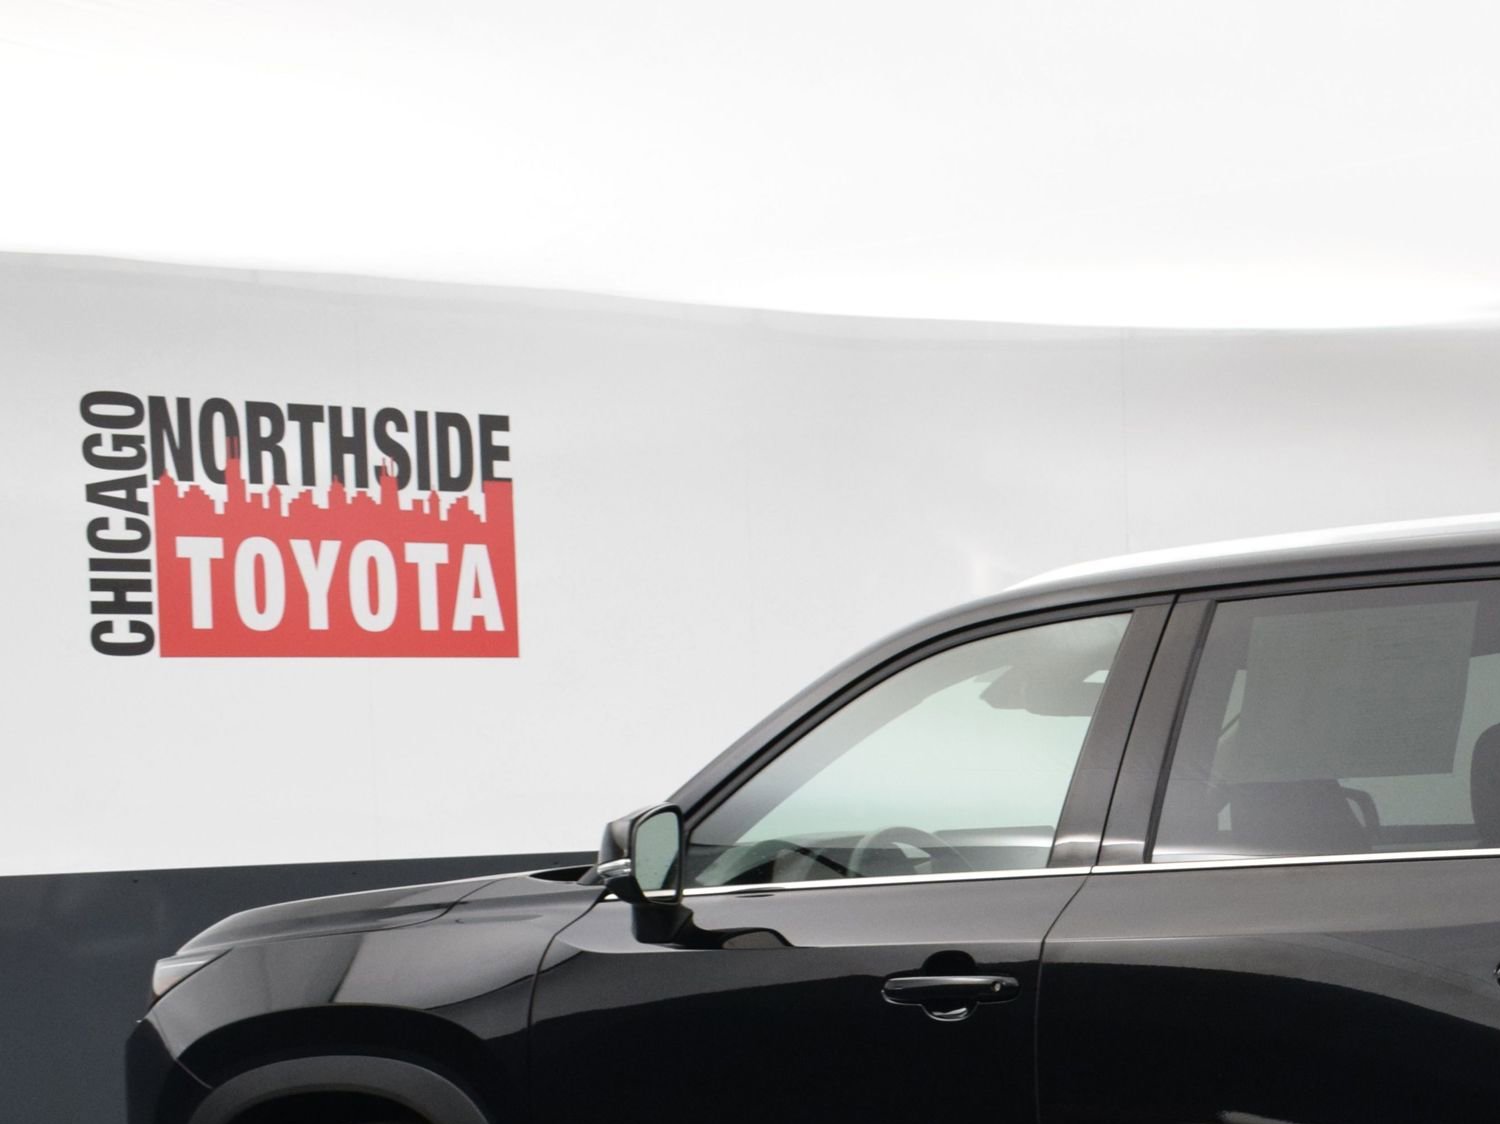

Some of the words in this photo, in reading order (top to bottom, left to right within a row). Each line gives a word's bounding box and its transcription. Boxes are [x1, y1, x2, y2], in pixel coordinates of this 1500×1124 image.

[148, 395, 512, 493] NORTHSIDE
[80, 390, 155, 657] CHICAGO
[175, 536, 505, 632] TOYOTA
